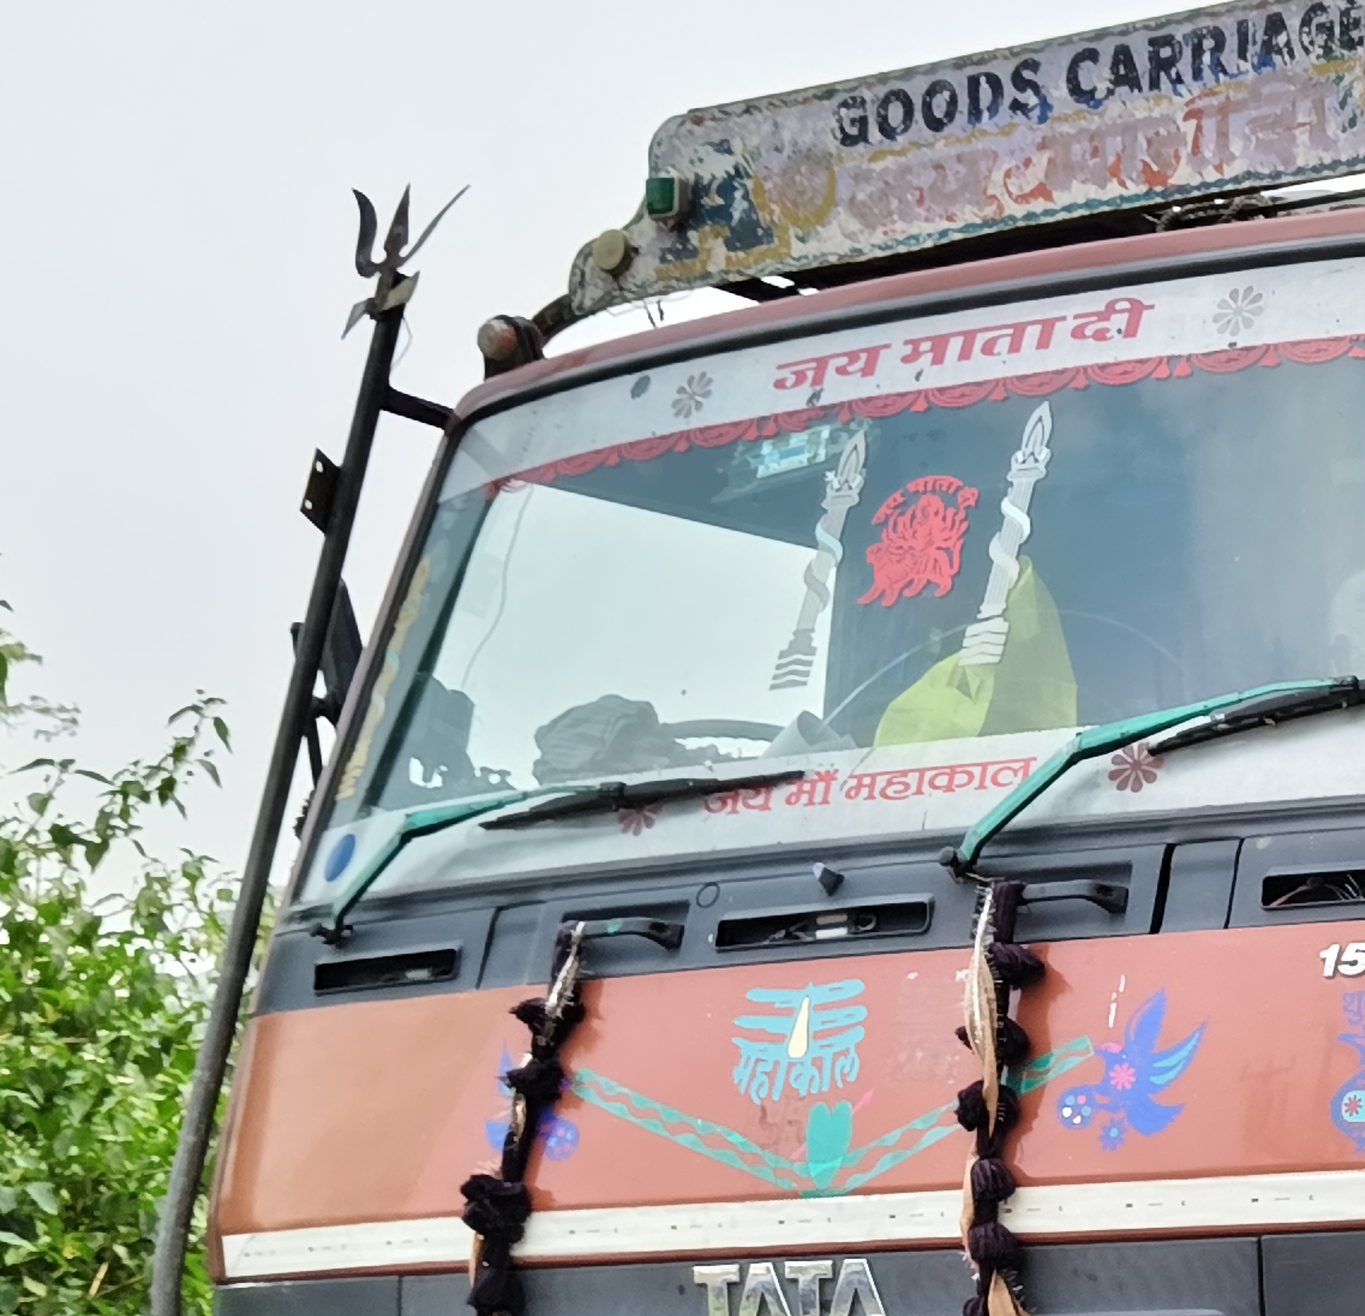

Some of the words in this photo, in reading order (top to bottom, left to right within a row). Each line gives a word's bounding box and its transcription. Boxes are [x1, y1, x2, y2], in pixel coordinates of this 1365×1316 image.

[832, 56, 1056, 147] GOODS
[1065, 0, 1365, 108] CARRIAGE
[772, 342, 892, 391] जय
[899, 315, 1068, 367] माता
[1069, 296, 1156, 343] दी
[844, 756, 1038, 801] महाकाल
[731, 1028, 865, 1107] महाकाल
